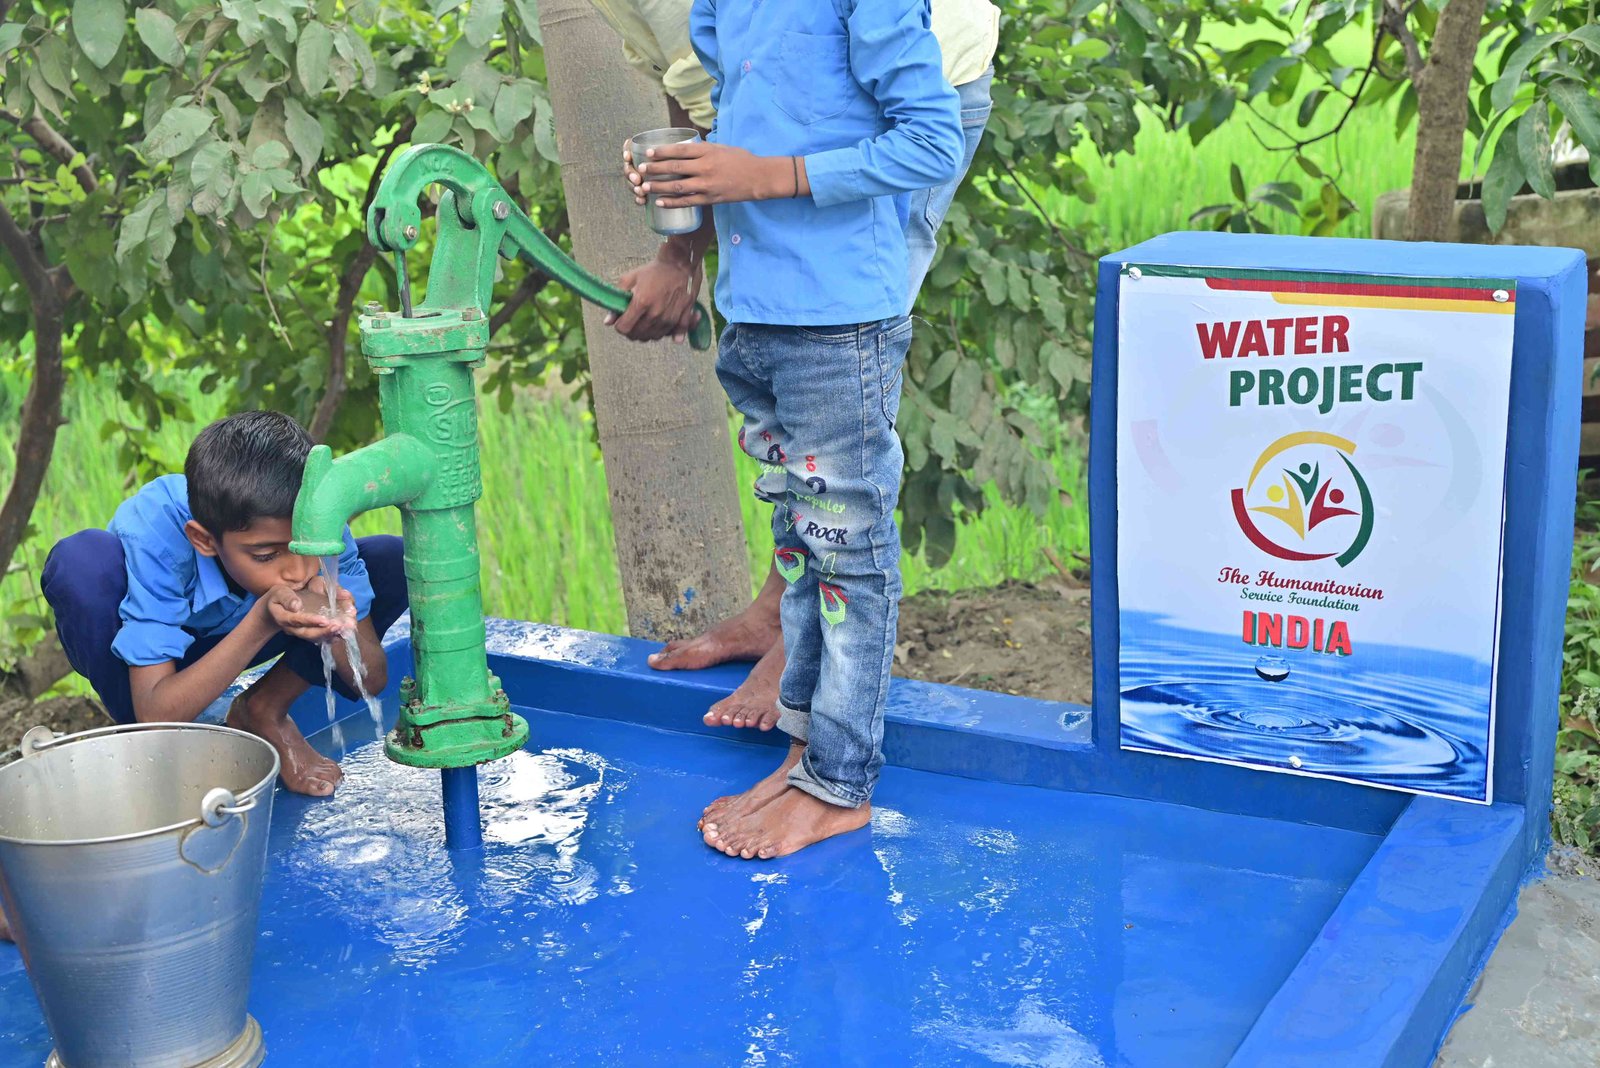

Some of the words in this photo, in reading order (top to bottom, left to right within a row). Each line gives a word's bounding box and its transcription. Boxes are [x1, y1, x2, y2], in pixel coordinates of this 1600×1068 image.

[1196, 315, 1350, 359] WATER
[1229, 362, 1423, 415] PROJECT
[803, 521, 849, 545] ROCK
[1217, 566, 1250, 585] The
[1255, 570, 1384, 600] Humanitarian
[1240, 587, 1284, 603] Service
[1288, 592, 1360, 612] Foundation
[1242, 610, 1353, 656] INDIA
